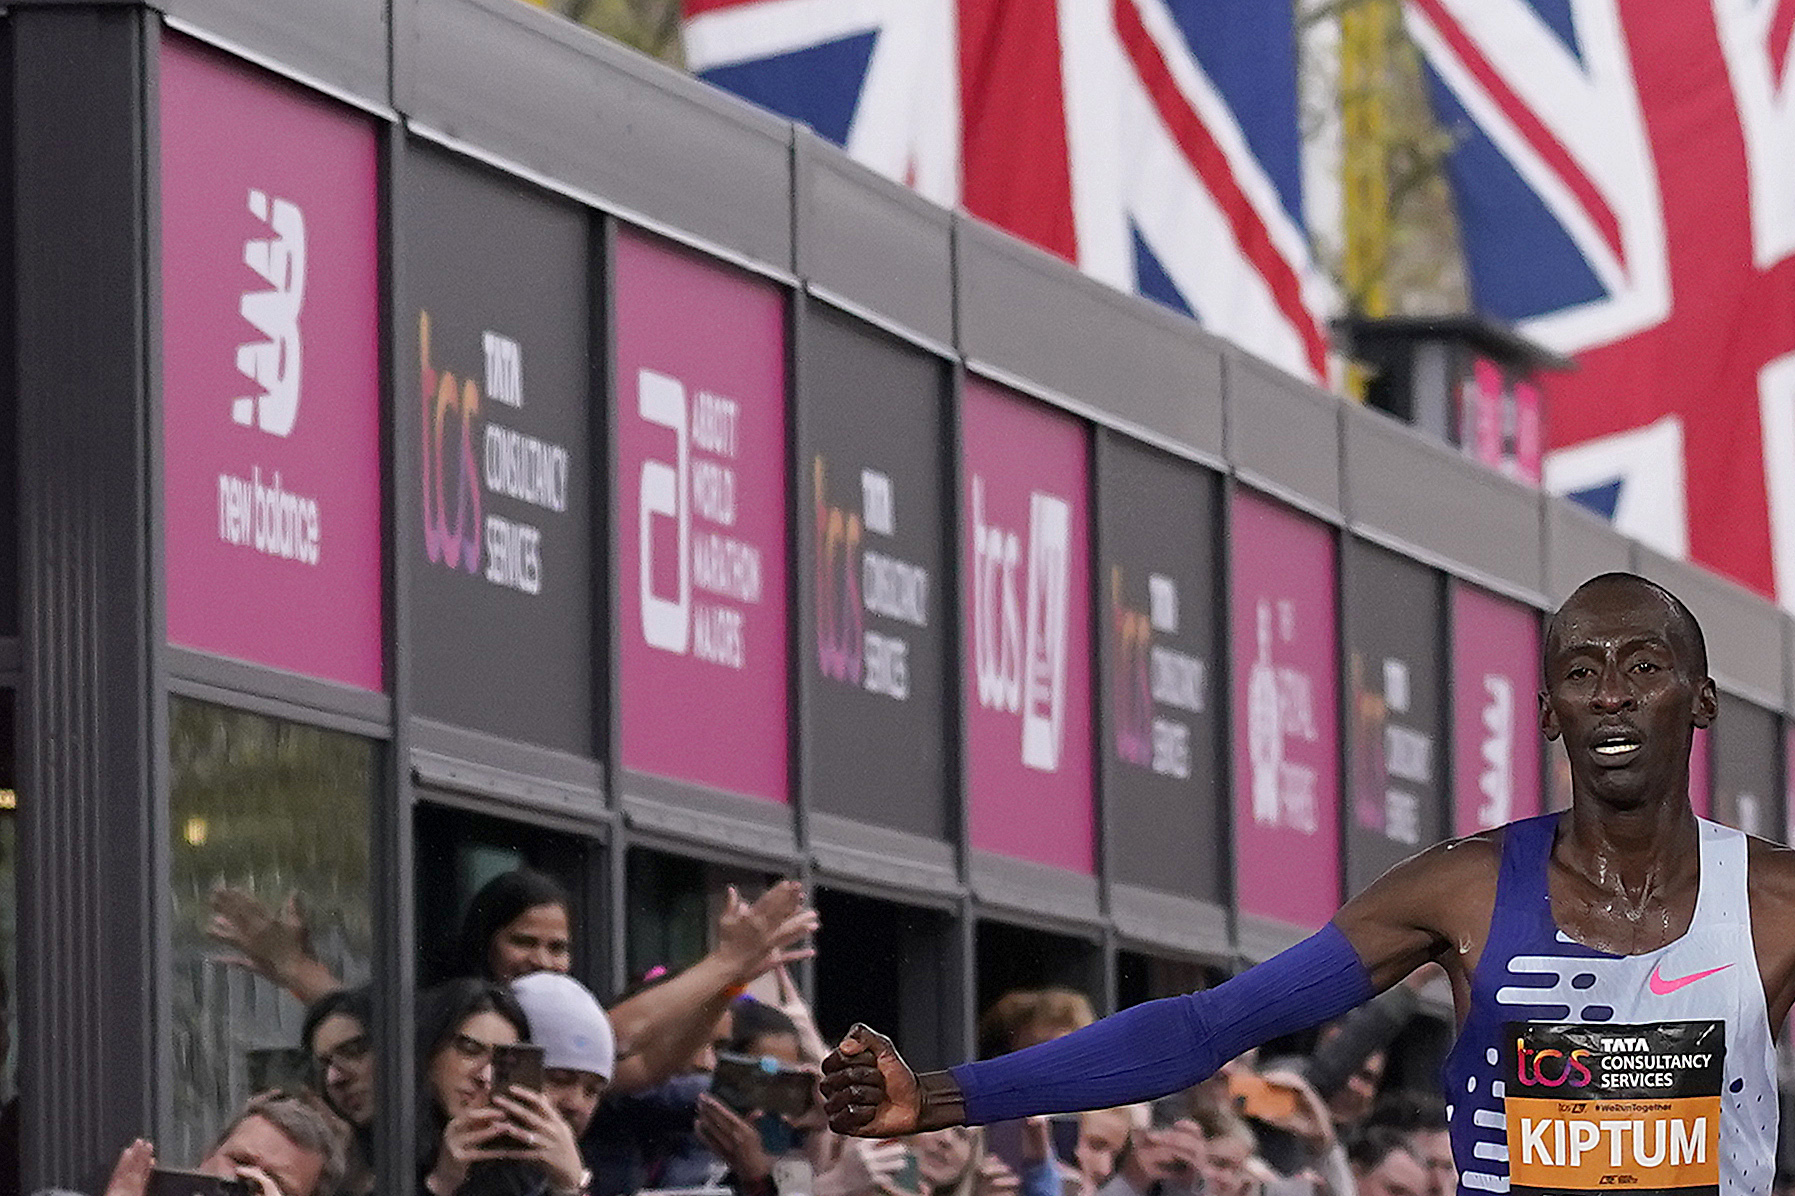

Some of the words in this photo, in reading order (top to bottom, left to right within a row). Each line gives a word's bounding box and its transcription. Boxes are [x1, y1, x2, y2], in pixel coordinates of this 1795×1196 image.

[419, 309, 481, 573] tcs
[219, 474, 251, 543] new
[254, 466, 321, 565] balance
[1517, 1038, 1592, 1087] tcs
[1601, 1038, 1649, 1052] TATA
[1601, 1054, 1712, 1070] CONSULTANCY
[1601, 1072, 1673, 1089] SERVICES
[1520, 1117, 1707, 1168] KIPTUM
